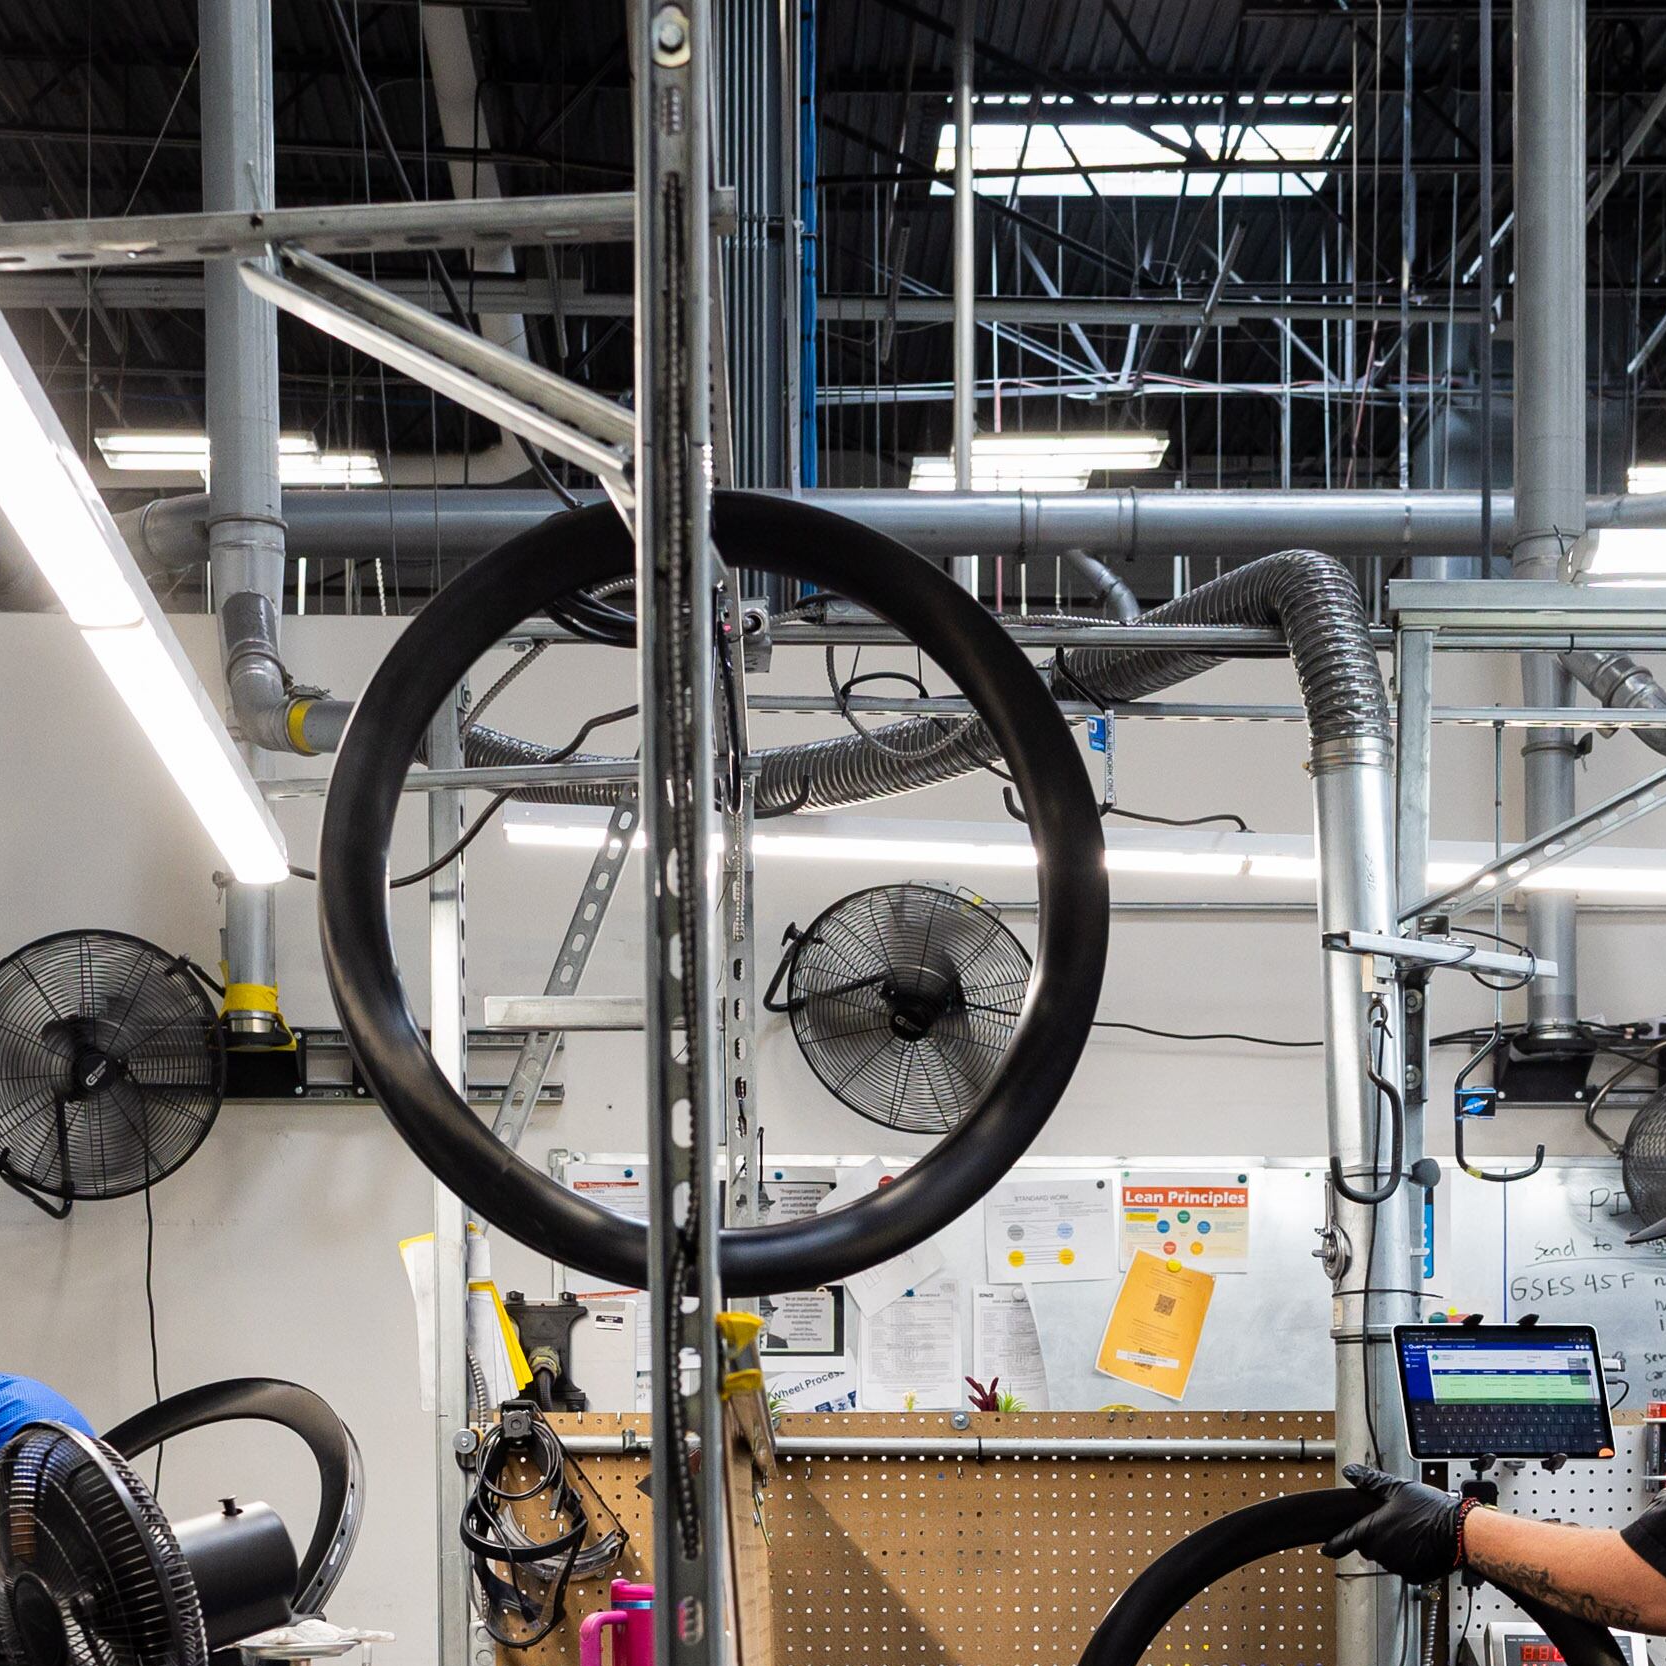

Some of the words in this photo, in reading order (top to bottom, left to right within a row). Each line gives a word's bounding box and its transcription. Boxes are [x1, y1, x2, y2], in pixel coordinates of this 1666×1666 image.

[1125, 1191, 1164, 1204] Lean
[1167, 1191, 1247, 1207] Principles
[1592, 1241, 1613, 1252] to
[770, 1379, 806, 1402] Wheel
